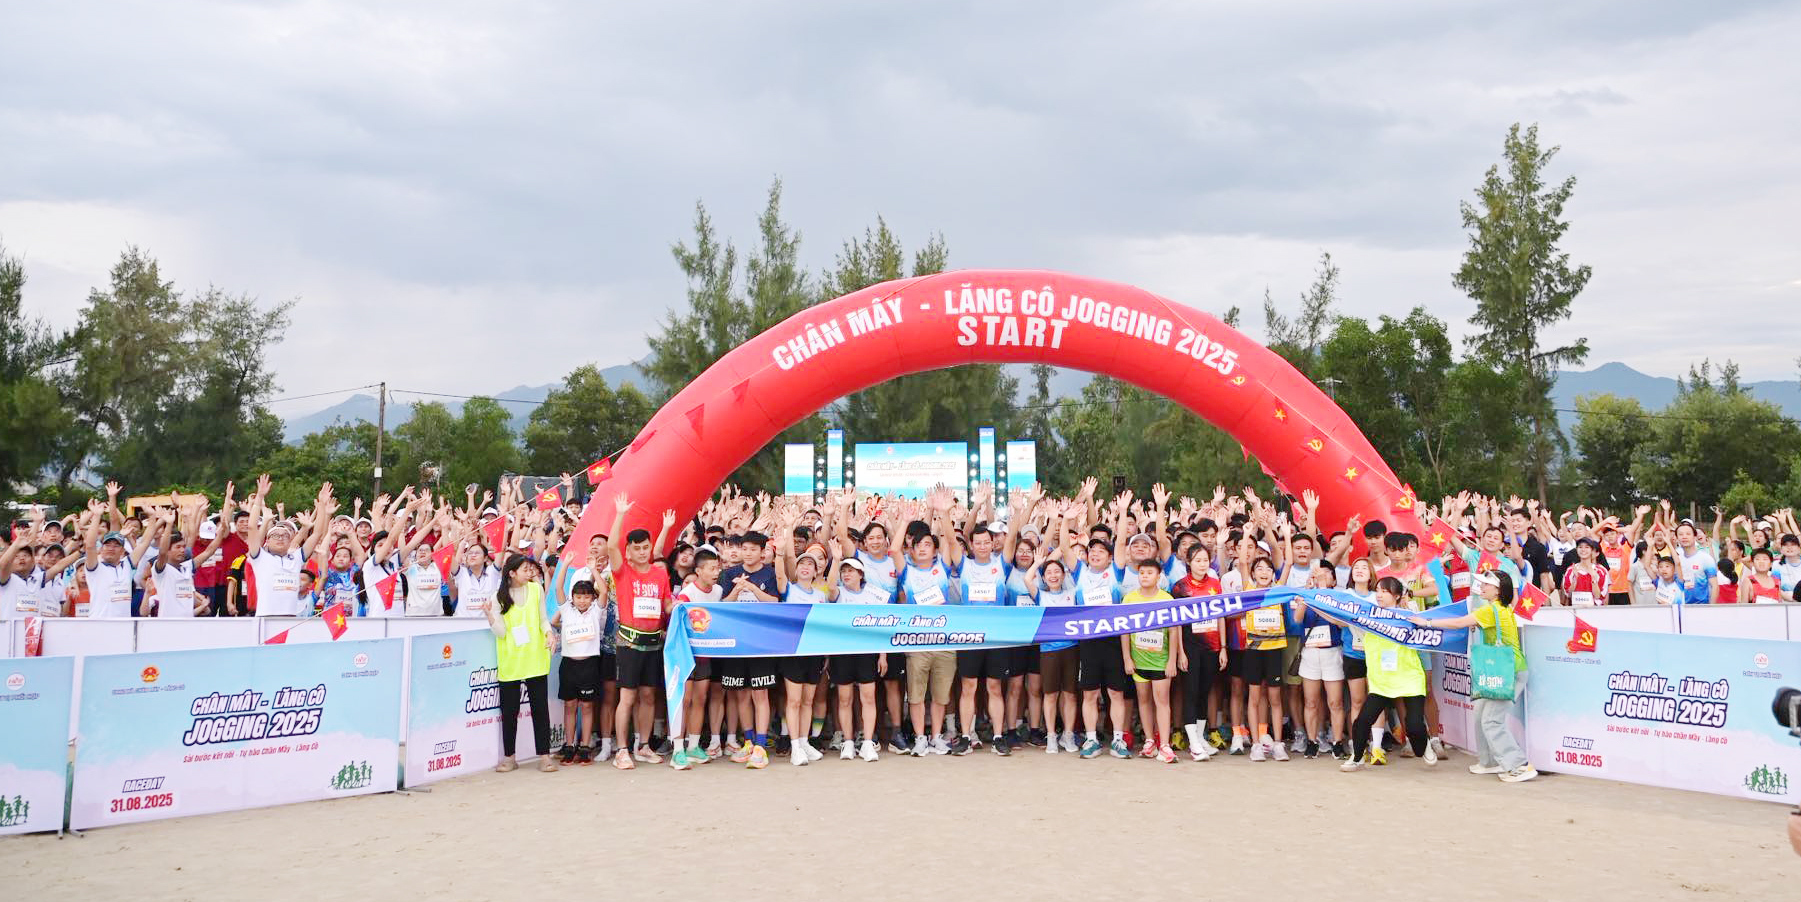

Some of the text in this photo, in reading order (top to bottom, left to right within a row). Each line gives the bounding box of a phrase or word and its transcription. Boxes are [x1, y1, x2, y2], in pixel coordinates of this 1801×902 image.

[772, 321, 847, 371] CHÂN
[846, 296, 904, 339] MÂY
[945, 282, 1012, 315] LĂNG
[1021, 285, 1055, 317] CÔ
[1061, 294, 1173, 347] JOGGING
[1175, 328, 1239, 376] 2025
[957, 315, 1070, 349] START
[852, 614, 878, 627] CHÂN
[877, 614, 901, 627] MÂY
[908, 614, 932, 627] LĂNG
[933, 614, 947, 627] CÔ
[1064, 595, 1243, 636] START/FINISH
[891, 632, 986, 646] JOGGING 2025
[1406, 628, 1443, 647] 2025
[469, 665, 489, 687] CHÂN
[1607, 670, 1640, 692] CHÂN
[1638, 673, 1668, 694] MÂY
[1678, 676, 1711, 699] LĂNG
[1711, 678, 1729, 700] CÔ
[191, 692, 230, 716] CHÂN
[227, 689, 263, 713] MÂY
[272, 686, 307, 709] LĂNG
[307, 683, 327, 706] CÔ
[1604, 692, 1728, 728] JOGGING 2025
[182, 707, 323, 746] JOGGING 2025
[427, 753, 462, 772] 31.08.2025
[1555, 750, 1603, 768] 31.08.2025
[122, 776, 165, 793] RACEDAY
[111, 792, 174, 813] 31.08.2025
